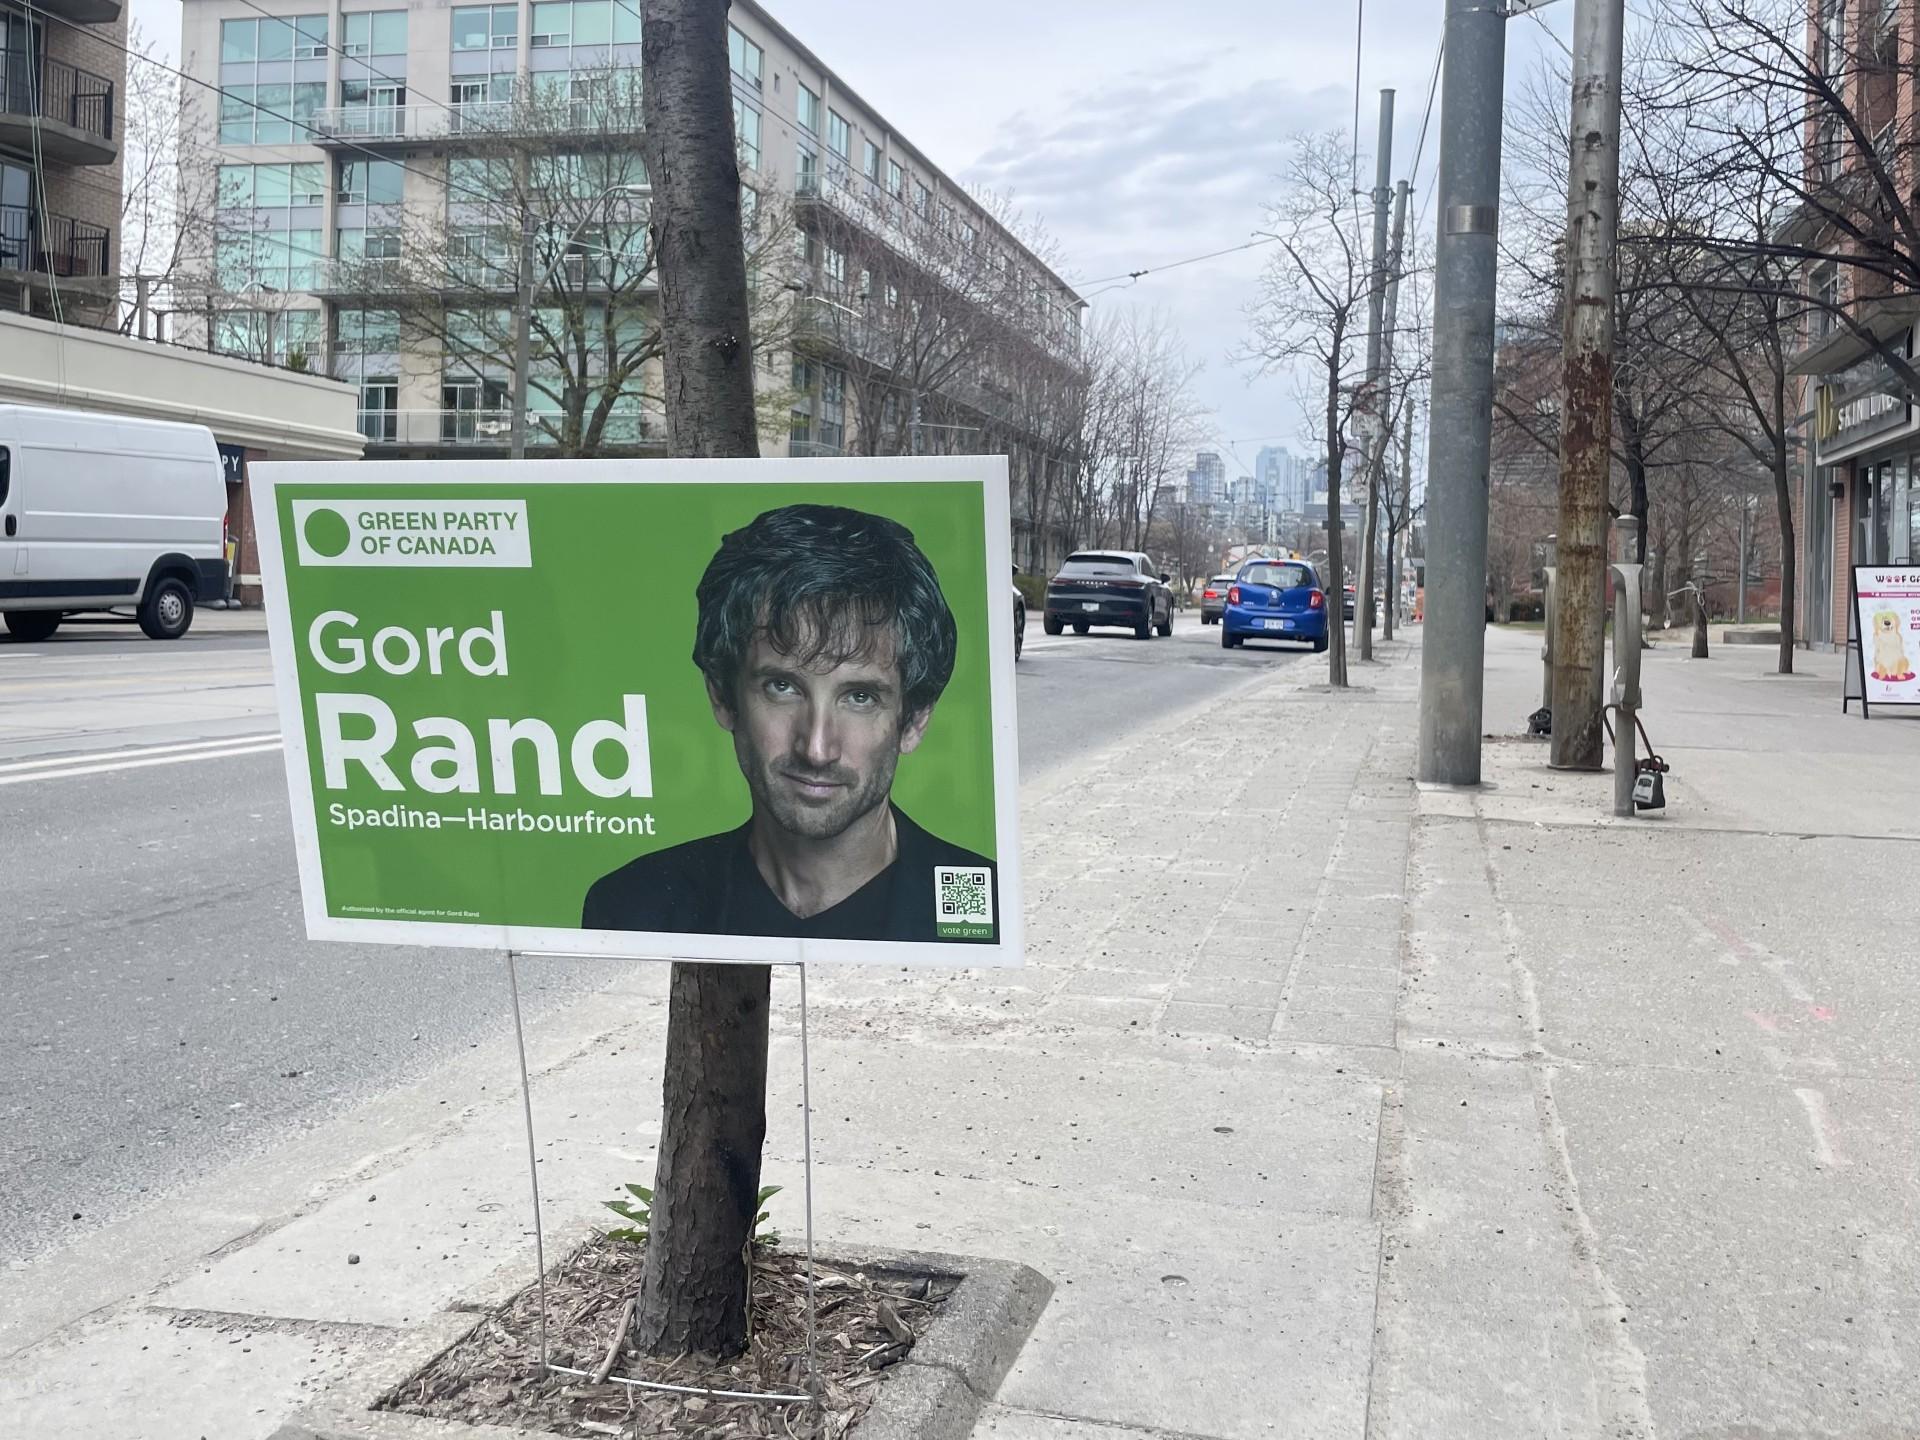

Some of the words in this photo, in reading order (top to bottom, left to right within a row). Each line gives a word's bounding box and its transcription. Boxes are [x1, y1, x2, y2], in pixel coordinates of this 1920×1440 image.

[357, 511, 438, 530] GREEN
[443, 511, 519, 531] PARTY
[360, 536, 391, 555] OF
[397, 536, 496, 555] CANADA
[308, 610, 509, 677] Gord
[315, 692, 653, 799] Rand
[942, 927, 961, 935] vote
[963, 928, 988, 936] green
